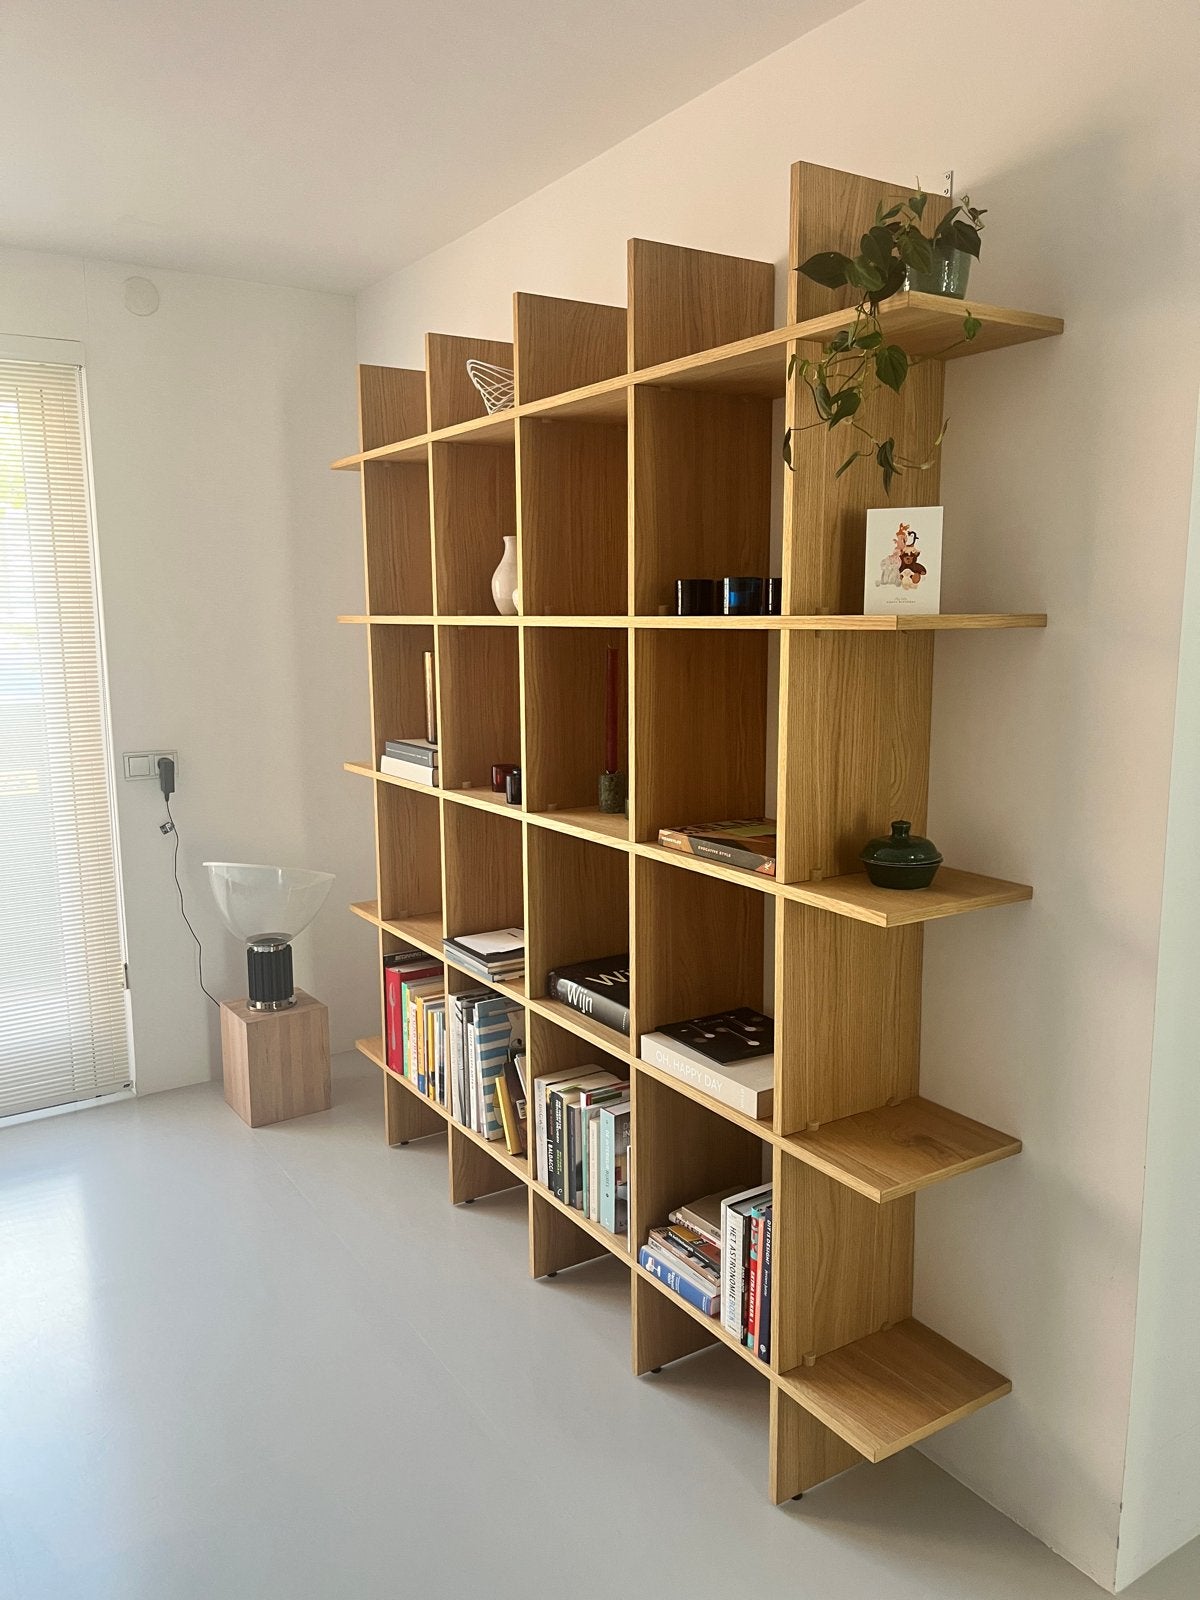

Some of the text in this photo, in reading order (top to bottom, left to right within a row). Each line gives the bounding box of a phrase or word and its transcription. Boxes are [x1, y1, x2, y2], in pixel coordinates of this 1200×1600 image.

[698, 845, 718, 854] EVOCATIVE
[567, 981, 592, 1014] Wijn
[673, 1060, 702, 1082] HAPPY
[704, 1074, 722, 1092] DAY
